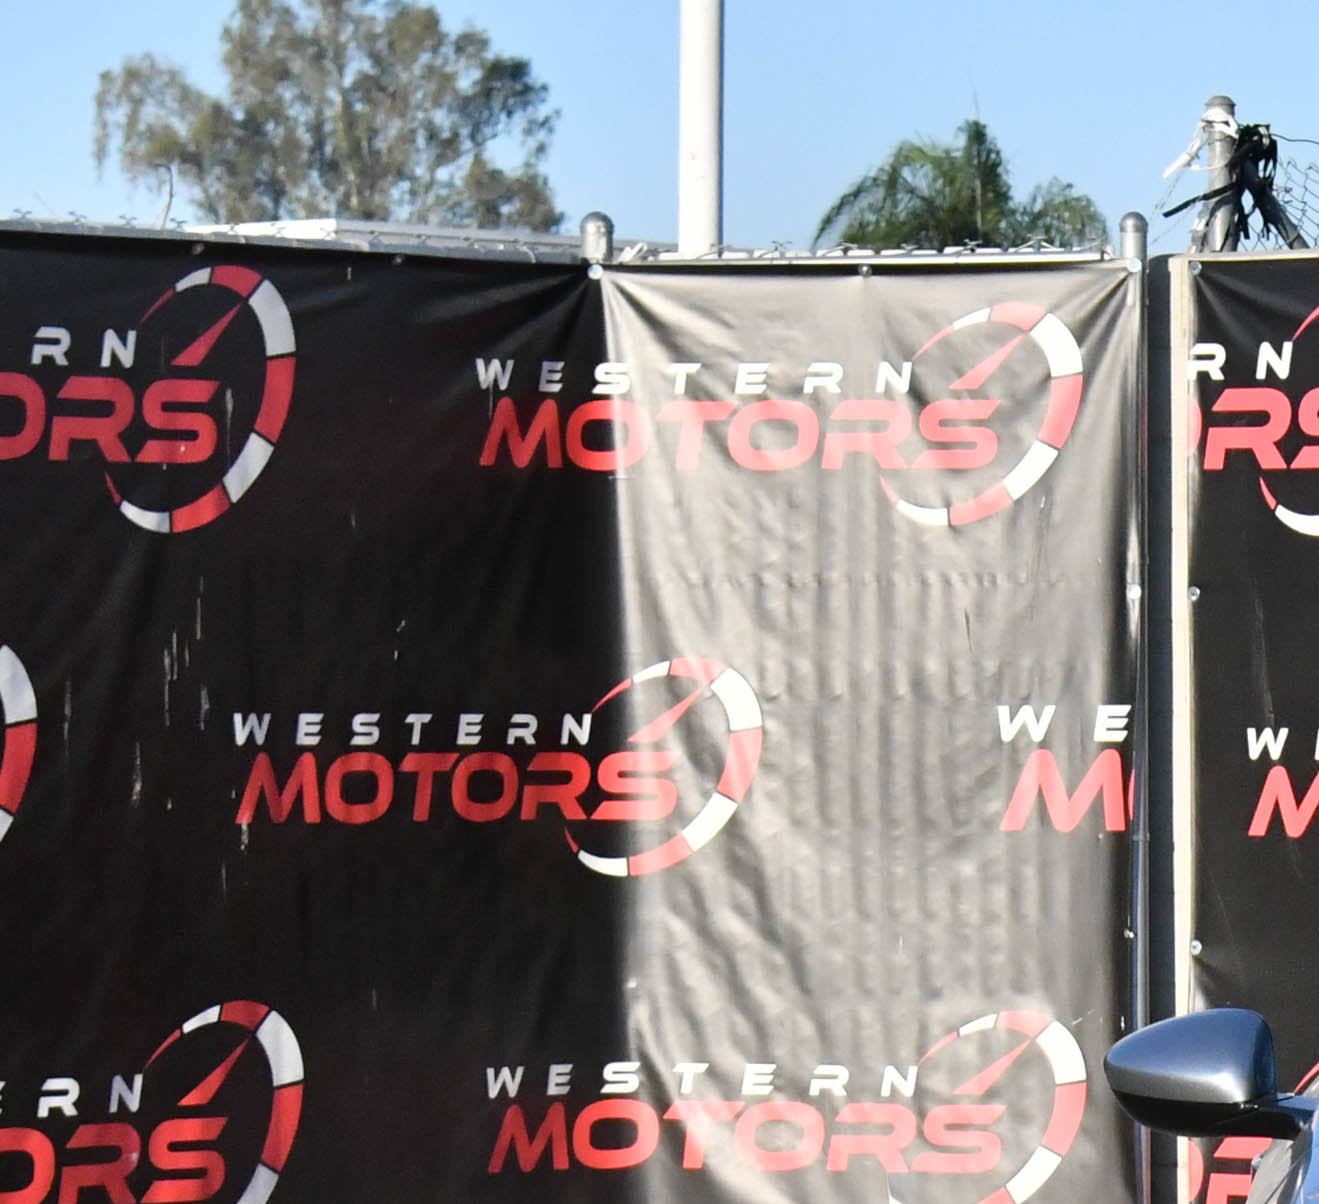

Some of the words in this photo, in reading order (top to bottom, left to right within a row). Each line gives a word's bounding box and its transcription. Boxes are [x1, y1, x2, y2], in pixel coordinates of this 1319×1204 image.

[475, 357, 913, 394] WESTERN
[480, 396, 1000, 471] MOTORS
[233, 712, 592, 746] WESTERN
[234, 750, 681, 825] MOTORS
[486, 1062, 919, 1099] WESTERN
[488, 1098, 1007, 1174] MOTORS
